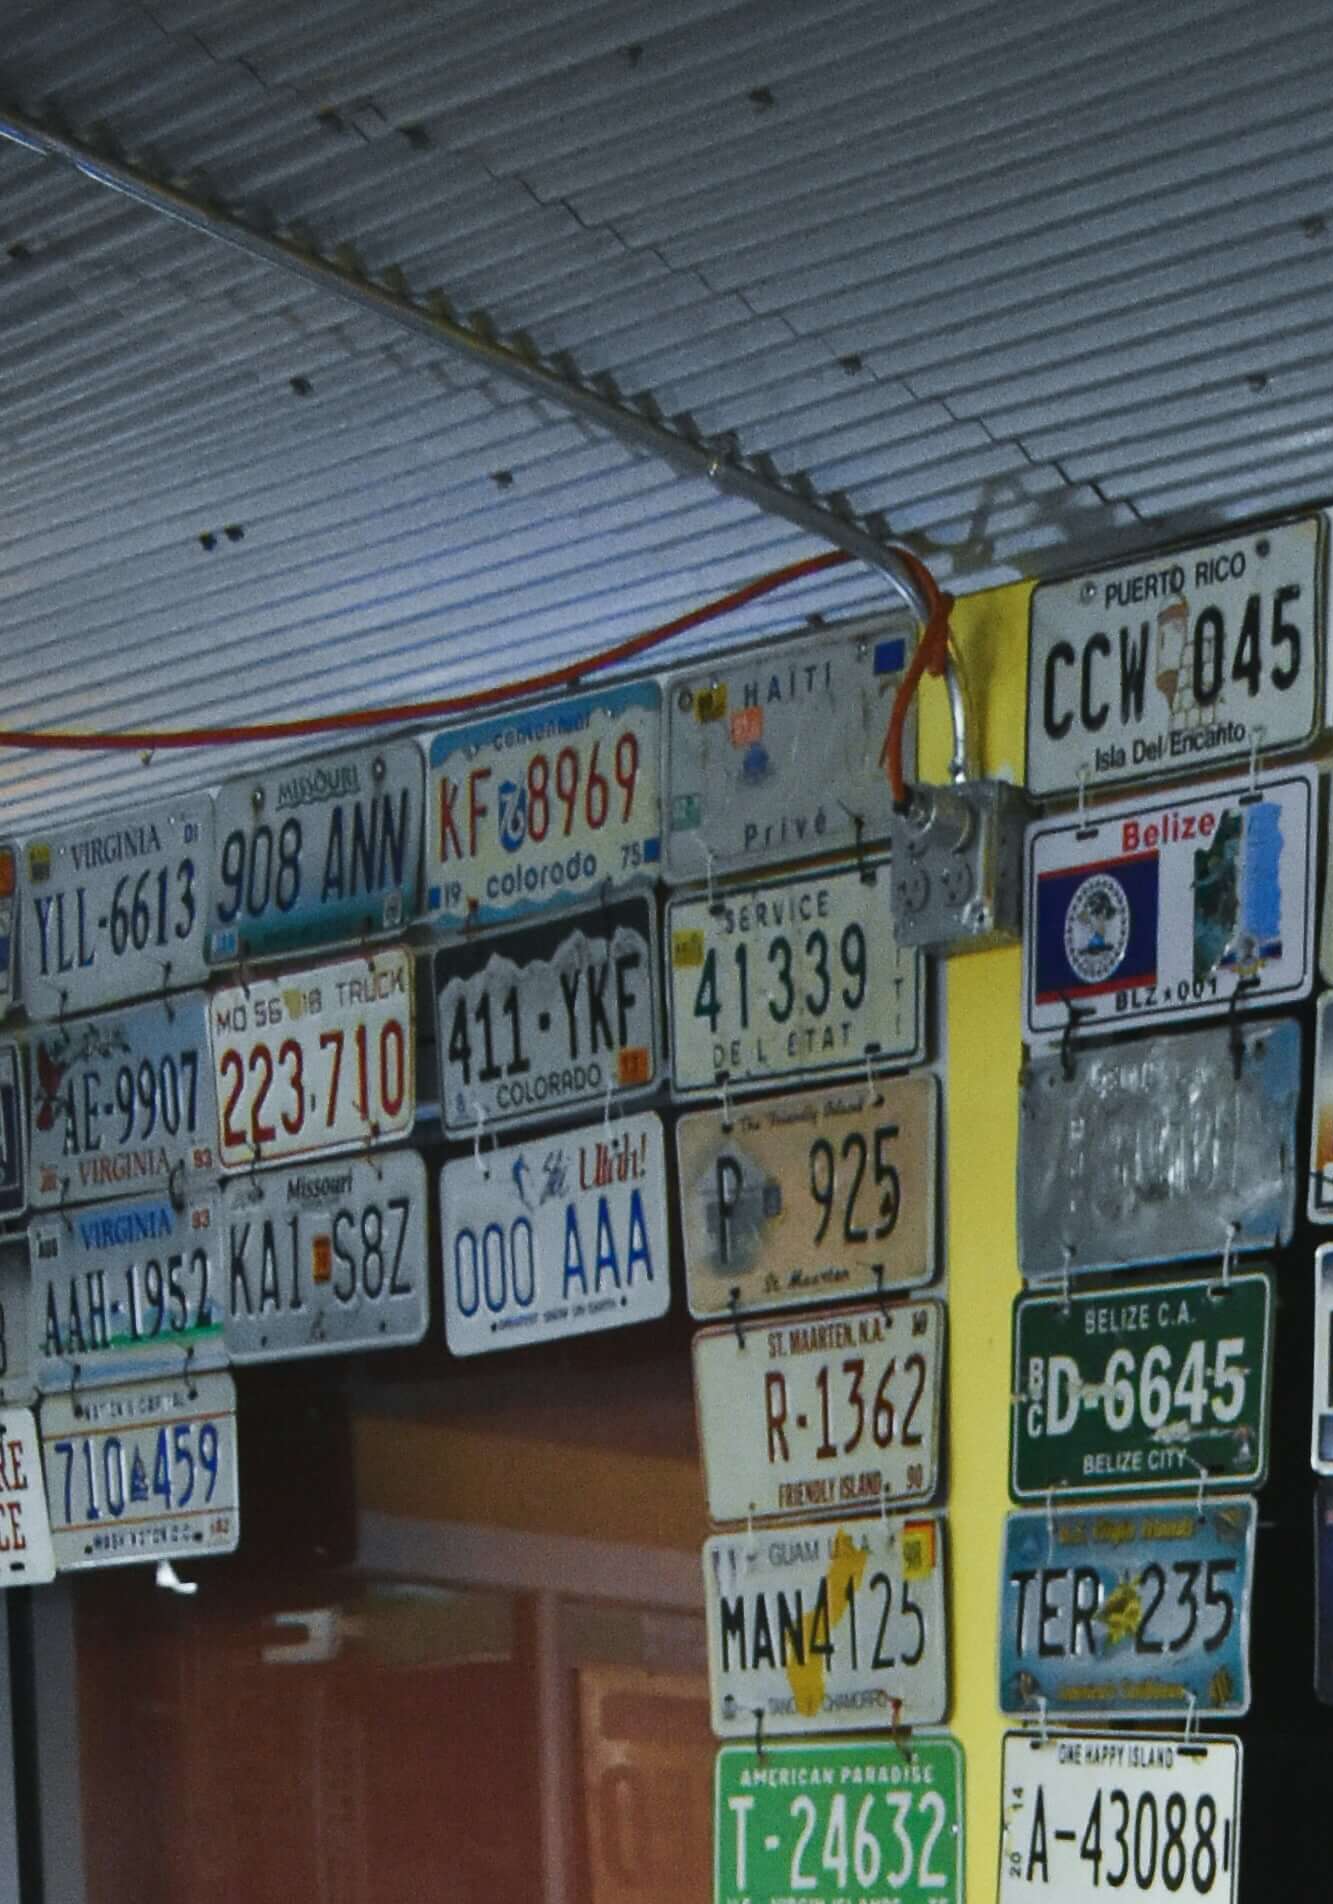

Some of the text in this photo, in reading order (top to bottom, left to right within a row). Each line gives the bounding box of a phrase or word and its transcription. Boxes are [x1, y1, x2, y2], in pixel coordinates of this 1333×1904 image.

[1104, 551, 1246, 609] PUERTO RICO
[1043, 583, 1302, 741] CCW 045
[1095, 722, 1246, 772] Isla Del Encanto
[275, 766, 360, 808] MISSOURI
[438, 731, 639, 863] KF 8969
[69, 824, 161, 873] VIRGINIA
[1121, 811, 1216, 851] Belize
[217, 788, 410, 924] 908 ANN
[33, 856, 197, 978] YLL-6613
[723, 890, 830, 935] SERVICE
[695, 922, 868, 1033] 41339
[712, 1021, 853, 1070] DE ETAT
[61, 1048, 199, 1156] AE-9907
[495, 1064, 601, 1108] COLORADO
[79, 1148, 170, 1186] VIRGINIA
[715, 1125, 901, 1265] P 925
[80, 1206, 175, 1251] VIRGINIA
[563, 1188, 653, 1299] AAA
[44, 1249, 212, 1357] AAH-1952
[1085, 1299, 1196, 1335] BELIZE C.A.
[55, 1423, 220, 1523] 710 459
[1082, 1447, 1188, 1475] BELIZE CITY
[778, 1470, 883, 1509] FRIENDLY ISLAND
[768, 1540, 820, 1568] GUAM
[1009, 1558, 1238, 1659] TER 235
[740, 1764, 935, 1789] AMERICAN PARADISE
[1058, 1743, 1174, 1770] ONE HAPPY ISLAND
[1026, 1785, 1217, 1895] A-43088
